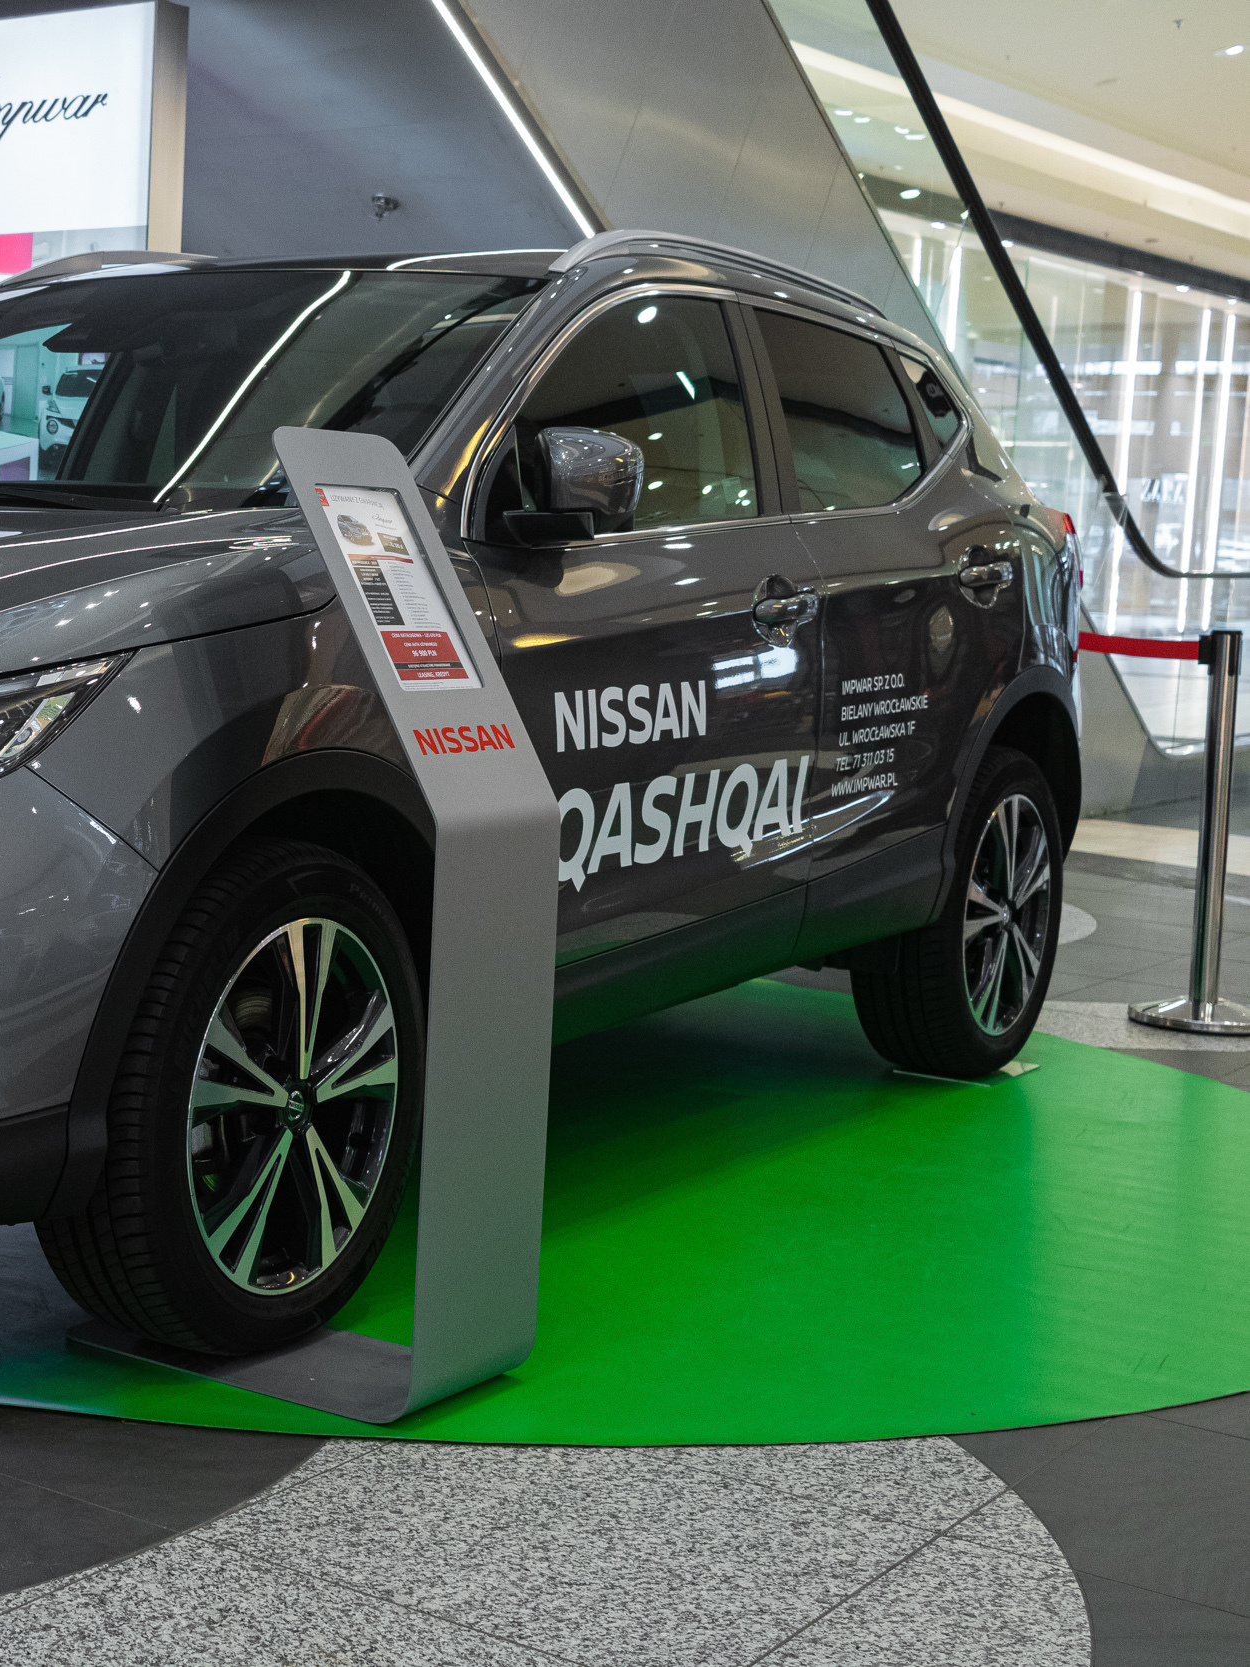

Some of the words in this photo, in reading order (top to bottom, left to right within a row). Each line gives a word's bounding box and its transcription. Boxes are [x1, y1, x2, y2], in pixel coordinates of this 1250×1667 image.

[842, 678, 872, 695] IMPWAR
[873, 676, 884, 691] SP.
[885, 675, 890, 690] Z
[890, 673, 905, 689] O.O.
[554, 680, 707, 753] NISSAN
[841, 703, 874, 721] BIELANY
[873, 694, 929, 716] WROCŁAWSKIE
[412, 723, 516, 756] NISSAN
[852, 722, 906, 744] WROCŁAWSKA
[907, 721, 916, 735] 1F
[852, 754, 861, 769] 71
[861, 752, 873, 768] 311
[874, 750, 885, 765] 03
[886, 748, 895, 762] 15
[831, 772, 899, 798] WWW.IMPWAR.PL
[558, 755, 810, 893] QASHQAI
